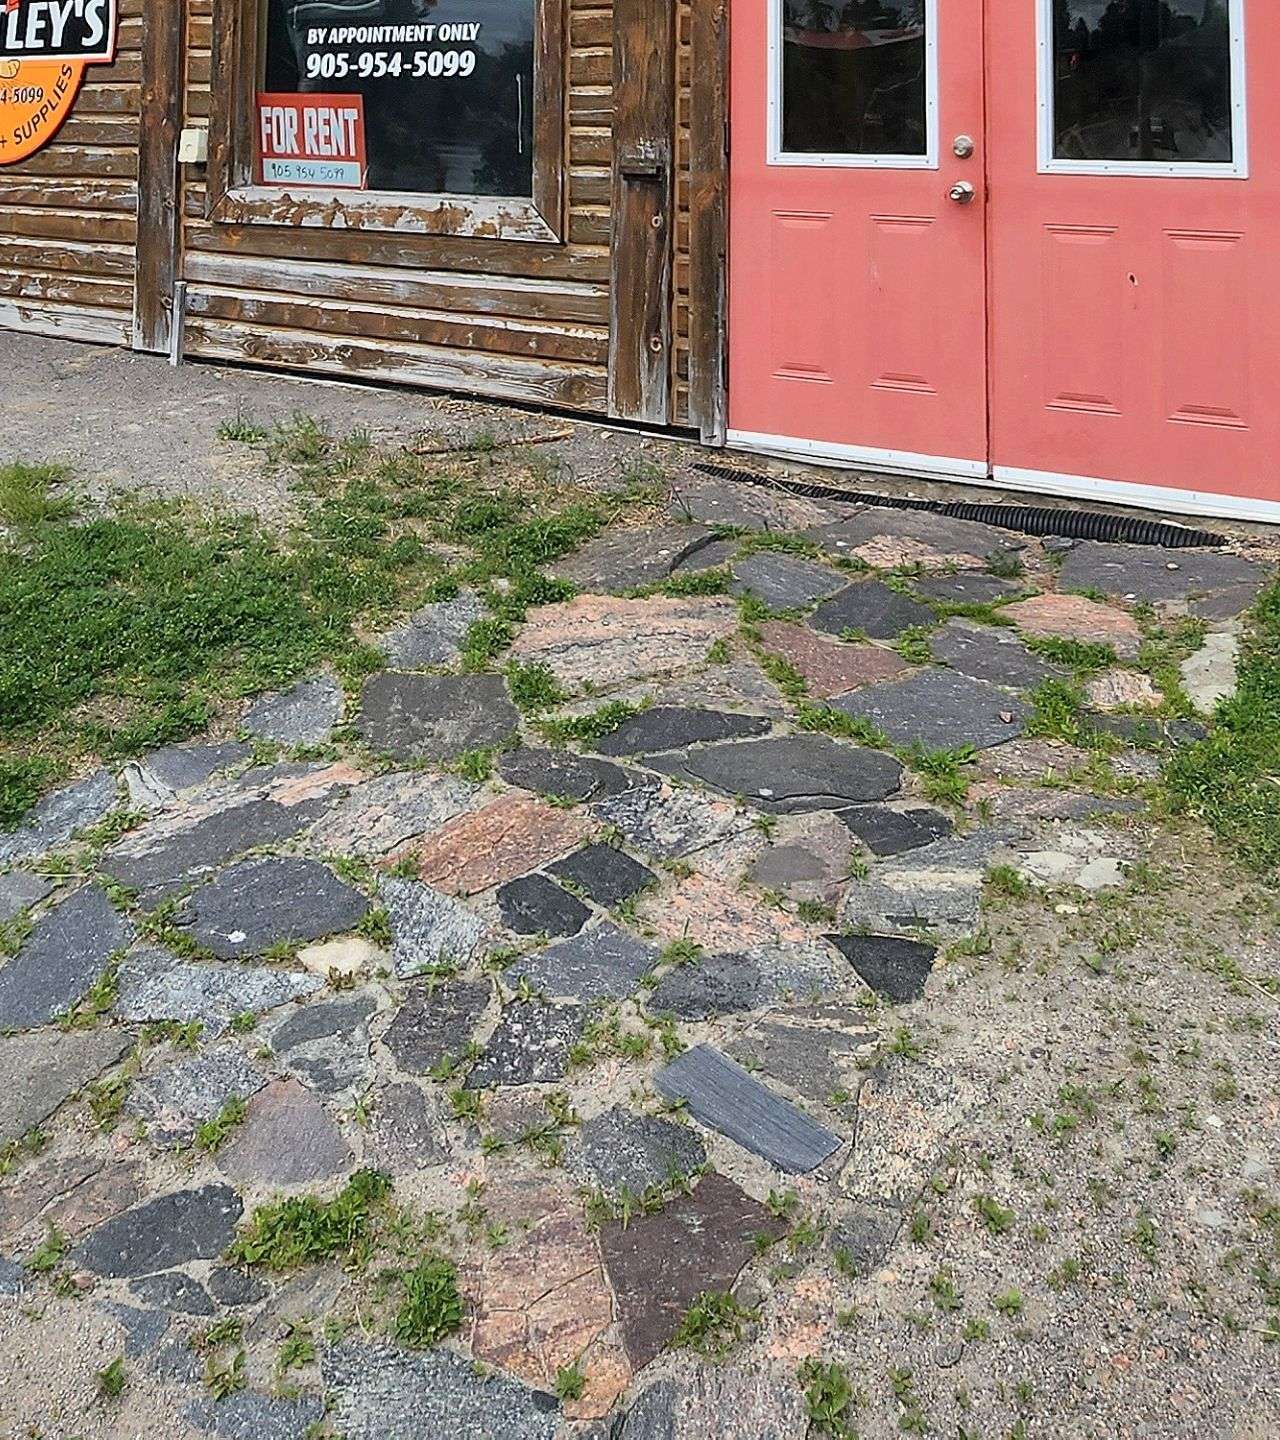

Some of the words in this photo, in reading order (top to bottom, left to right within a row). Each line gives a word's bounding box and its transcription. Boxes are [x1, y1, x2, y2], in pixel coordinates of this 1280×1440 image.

[307, 28, 329, 45] BY
[328, 25, 435, 44] APPOINTMENT
[438, 23, 480, 42] ONLY
[306, 50, 476, 79] 905-954-5099
[13, 63, 73, 146] SUPPLIES
[261, 106, 300, 155] FOR
[303, 107, 359, 157] RENT
[271, 163, 292, 179] 905
